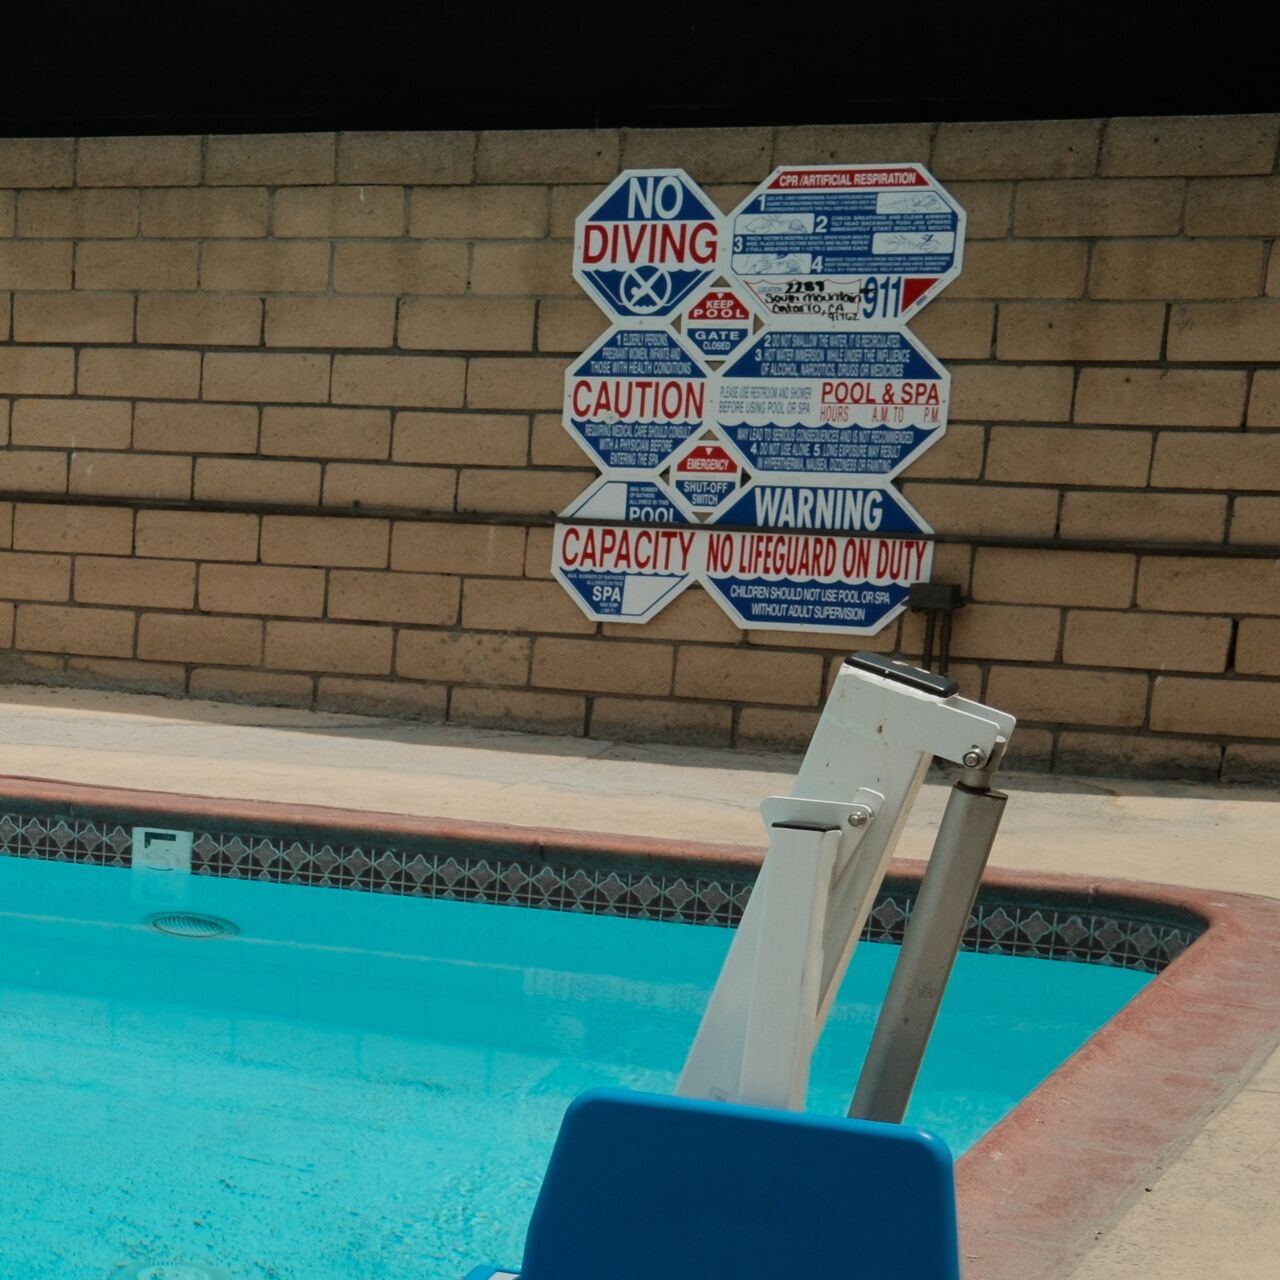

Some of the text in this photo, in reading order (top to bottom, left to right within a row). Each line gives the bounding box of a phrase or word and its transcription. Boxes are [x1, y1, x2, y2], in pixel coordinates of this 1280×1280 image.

[778, 177, 800, 187] CPR
[854, 172, 916, 185] RESPIRATION
[627, 176, 684, 220] NO
[758, 194, 765, 212] 1
[815, 216, 828, 233] 2
[582, 222, 718, 264] DIVING
[734, 236, 743, 252] 3
[811, 256, 824, 272] 4
[706, 300, 734, 309] KEEP
[862, 276, 902, 319] 911
[693, 309, 744, 318] POOL
[695, 331, 740, 340] GATE
[703, 341, 731, 350] CLOSED
[591, 361, 691, 374] THOSE WITH HEALTH CONDITIONS
[760, 363, 770, 376] OF
[838, 364, 859, 376] DRUGS
[860, 364, 870, 377] OR
[870, 364, 904, 377] MEDICINES
[572, 380, 704, 418] CAUTION
[822, 382, 939, 404] POOL & SPA
[719, 401, 810, 414] BEFORE USING POOL OR SPA
[821, 406, 849, 422] HOURS
[894, 407, 904, 422] TO
[687, 459, 729, 471] EMERGENCY
[684, 482, 728, 493] SHUT-OFF
[692, 494, 718, 505] SWITCH
[629, 507, 677, 522] POOL
[754, 488, 883, 531] WARNING
[562, 528, 696, 571] CAPACITY
[706, 533, 928, 581] NO LIFEGUARD ON DUTY
[592, 586, 621, 602] SPA
[730, 585, 891, 604] CHILDREN SHOULD NOT USE POOL OR SPA
[752, 603, 866, 621] WITHOUT ADULT SUPERVISION
